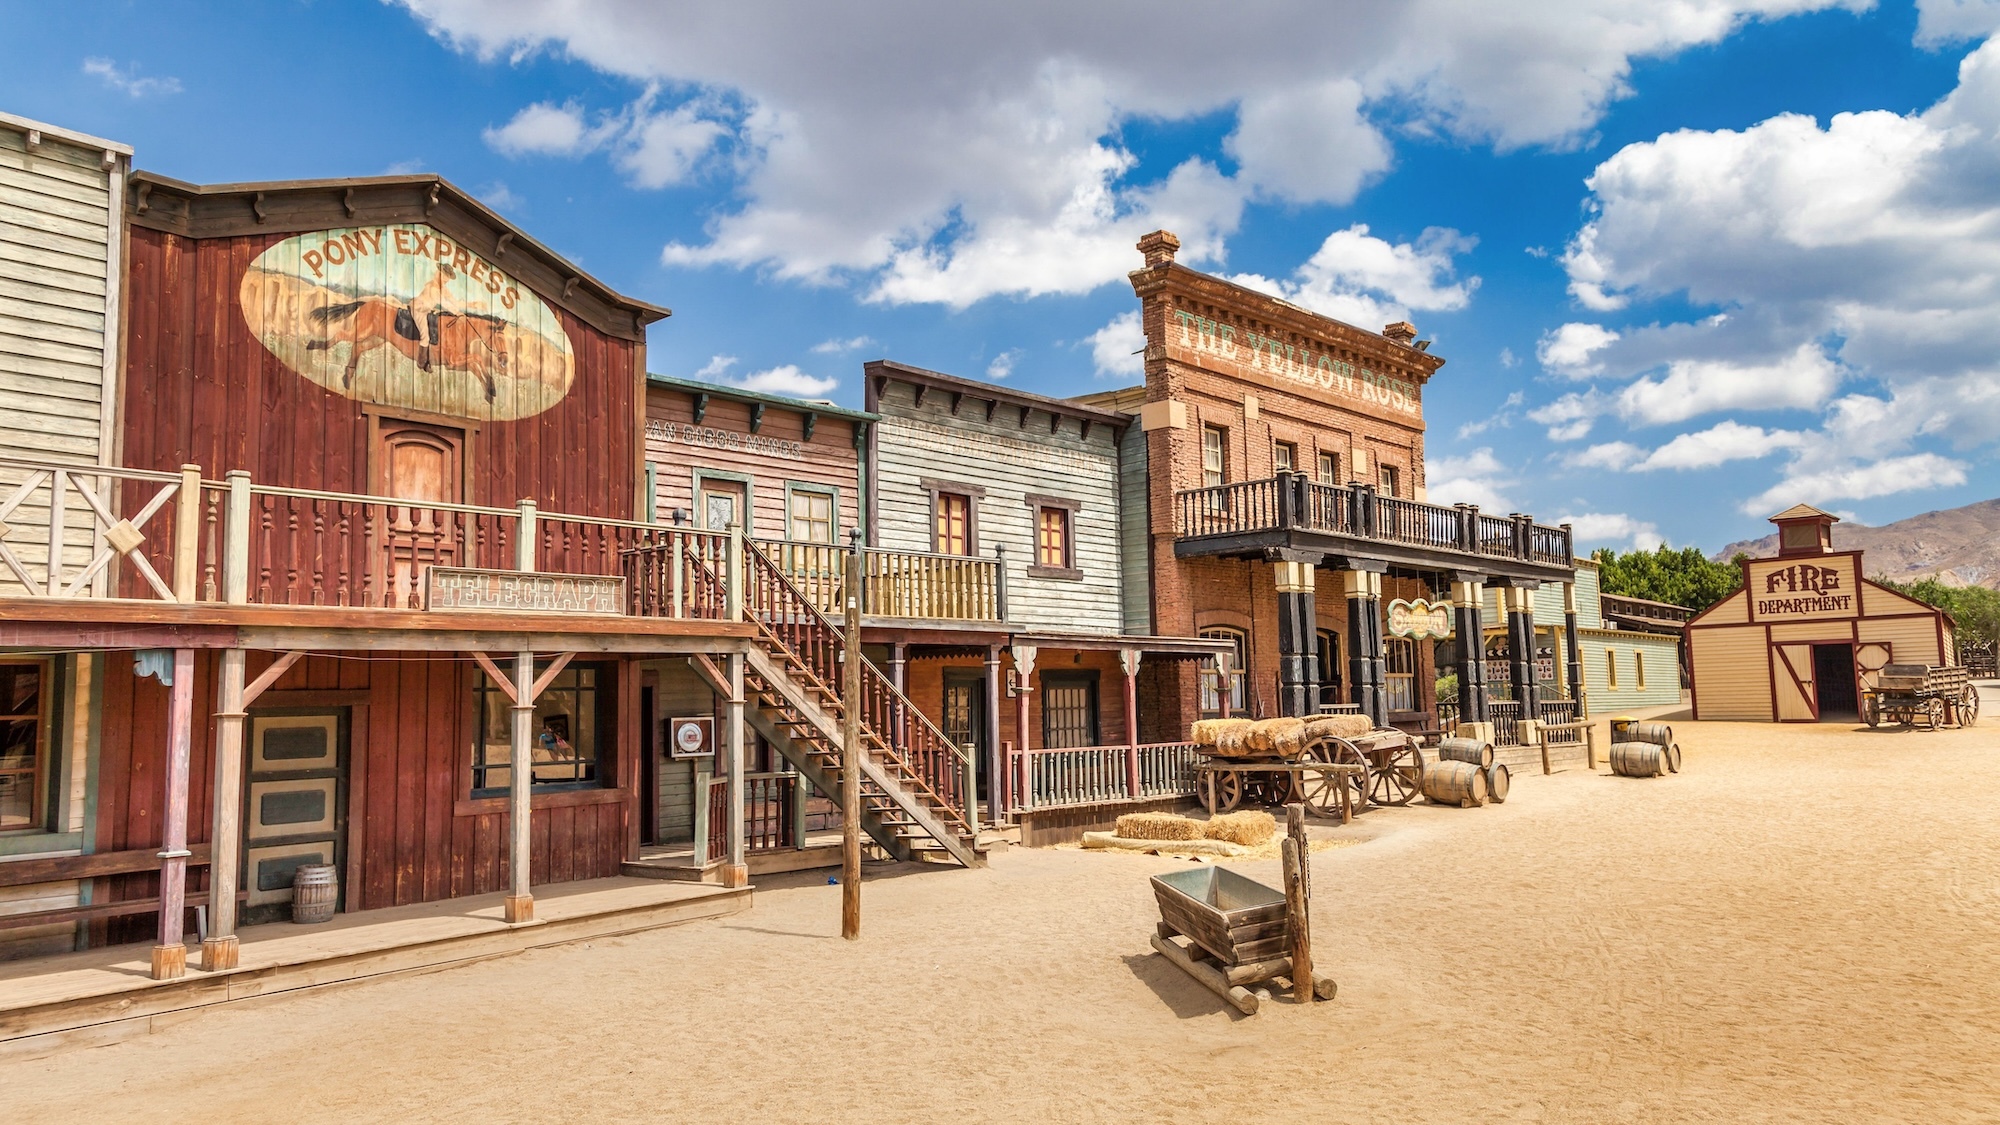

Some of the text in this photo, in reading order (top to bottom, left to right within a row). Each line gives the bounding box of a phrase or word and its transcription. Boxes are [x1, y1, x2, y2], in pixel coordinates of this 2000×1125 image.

[302, 229, 520, 310] PONY EXPRESS
[1174, 309, 1417, 413] THE YELLOW ROSE
[683, 424, 740, 451] DIEGO
[745, 434, 802, 460] MINES
[438, 572, 616, 612] TELEGRAPH
[1766, 564, 1840, 596] FIRE
[1758, 595, 1851, 615] DEPARTMENT
